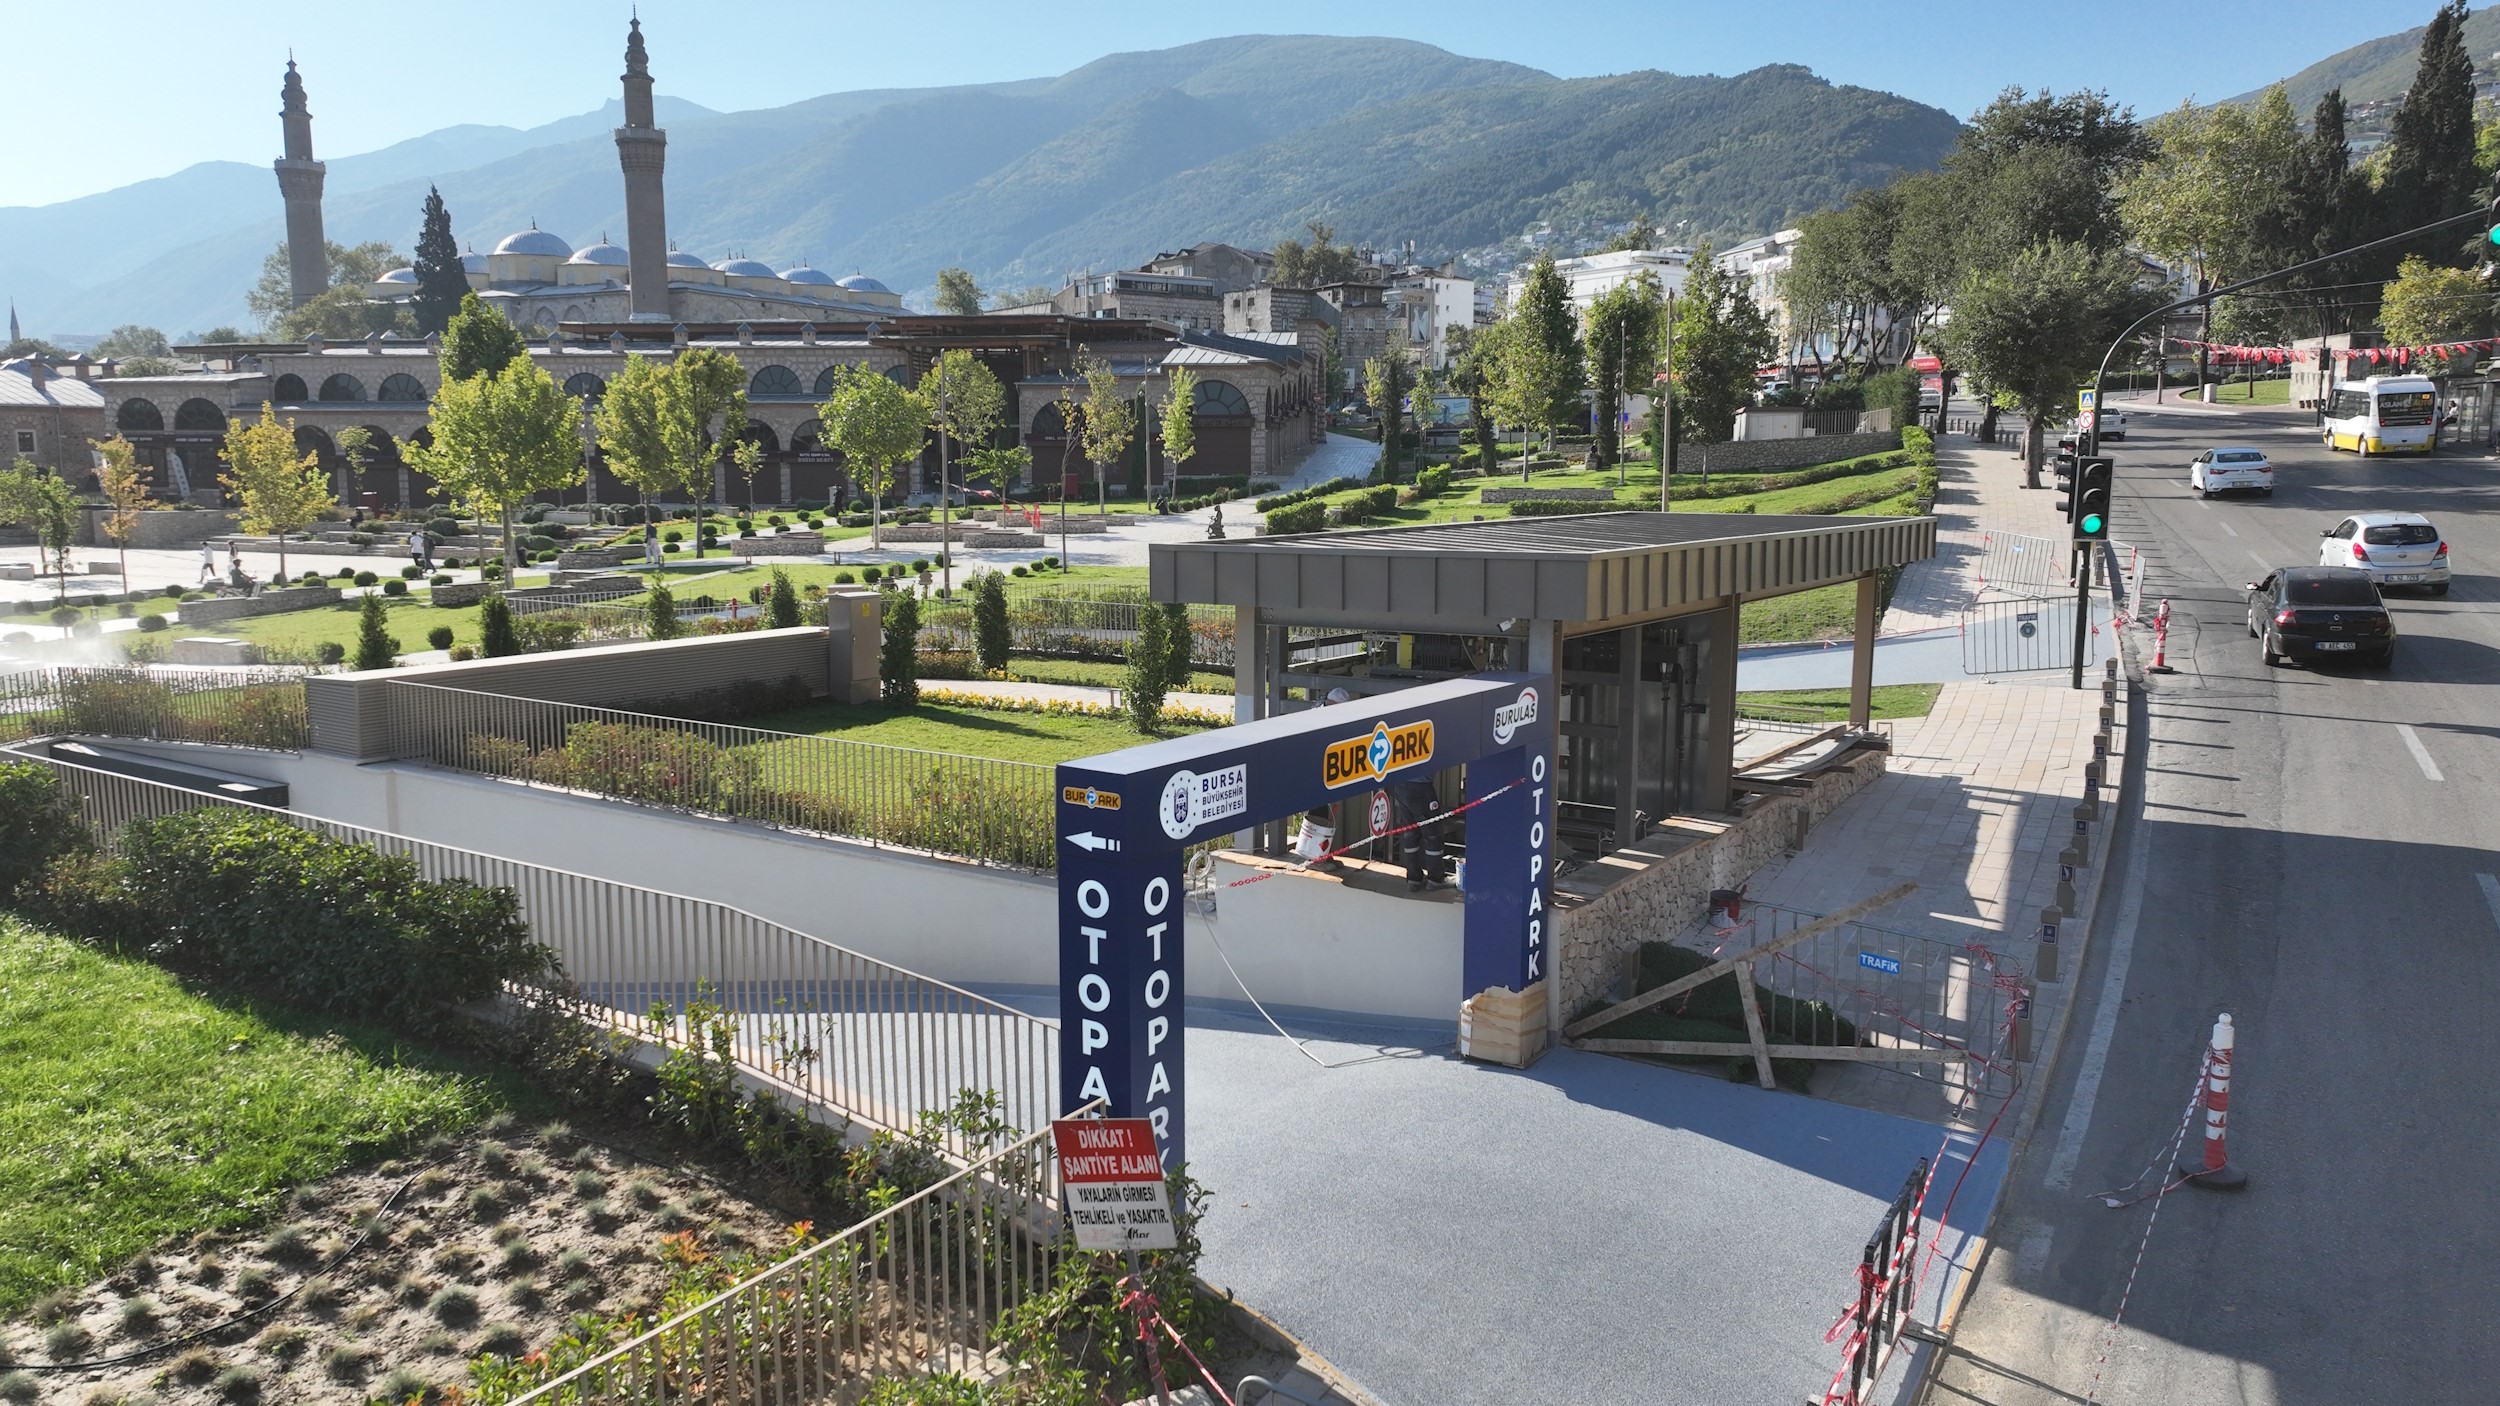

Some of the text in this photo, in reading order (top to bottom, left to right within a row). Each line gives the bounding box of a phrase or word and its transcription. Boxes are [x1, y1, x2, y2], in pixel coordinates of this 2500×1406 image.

[1495, 702, 1536, 729] BURULAŞ
[1202, 769, 1243, 793] BURSA
[1202, 785, 1244, 806] BÜYÜKŞEHİR
[1202, 796, 1244, 819] BELEDİYESİ
[1527, 754, 1546, 980] OTOPARK
[1077, 1124, 1125, 1149] DİKKAT
[1063, 1151, 1159, 1181] ŞANTİYE ALANI
[1077, 1183, 1157, 1203] YAYALARIN GİRMESİ
[1073, 1205, 1170, 1226] TEHLİKELİ ve YASAKTIR.
